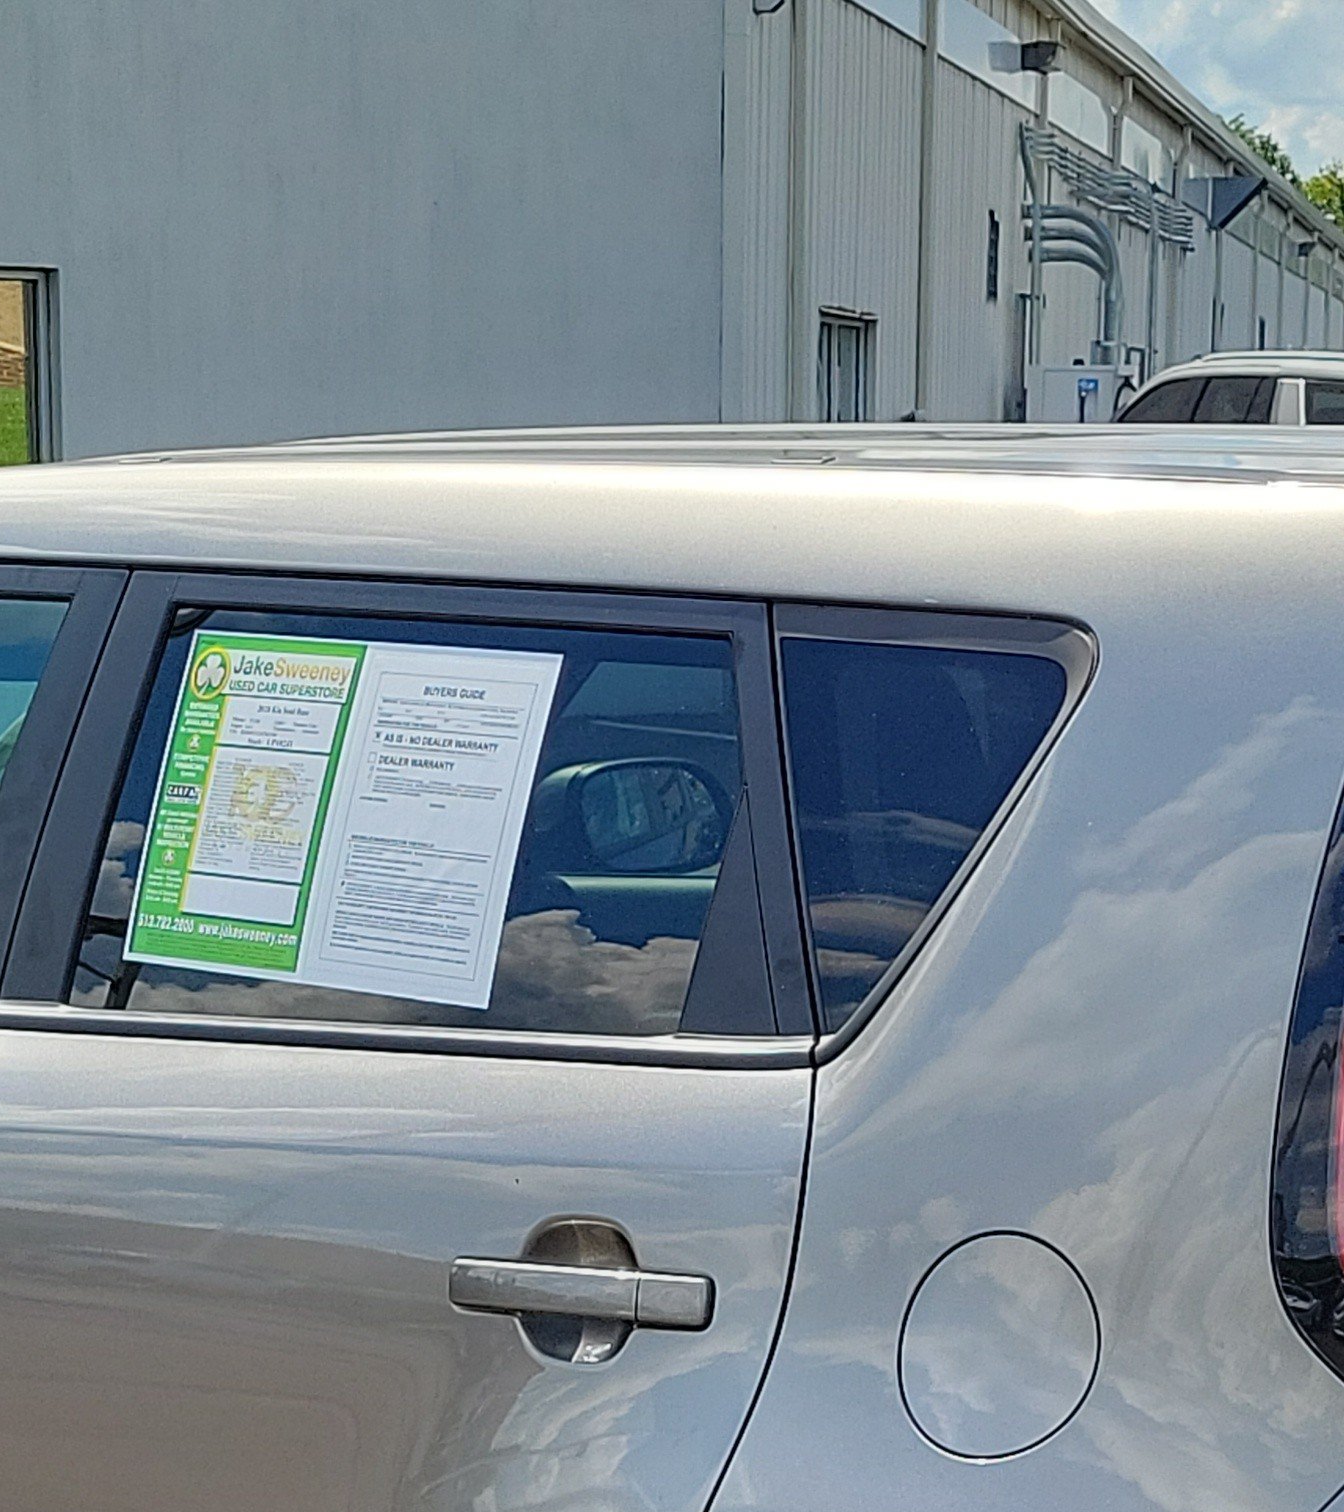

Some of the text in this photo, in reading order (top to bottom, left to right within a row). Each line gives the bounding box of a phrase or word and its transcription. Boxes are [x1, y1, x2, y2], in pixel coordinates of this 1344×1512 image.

[233, 654, 352, 686] JakeSweeney
[228, 680, 346, 699] USED CAR SUPERSTORE
[423, 685, 486, 700] BUYERS GUIDE
[384, 732, 397, 743] AS
[397, 733, 404, 743] IS
[409, 734, 421, 745] NO
[421, 735, 454, 748] DEALER
[454, 738, 499, 753] WARRANTY
[378, 755, 455, 771] DEALER WARRANTY
